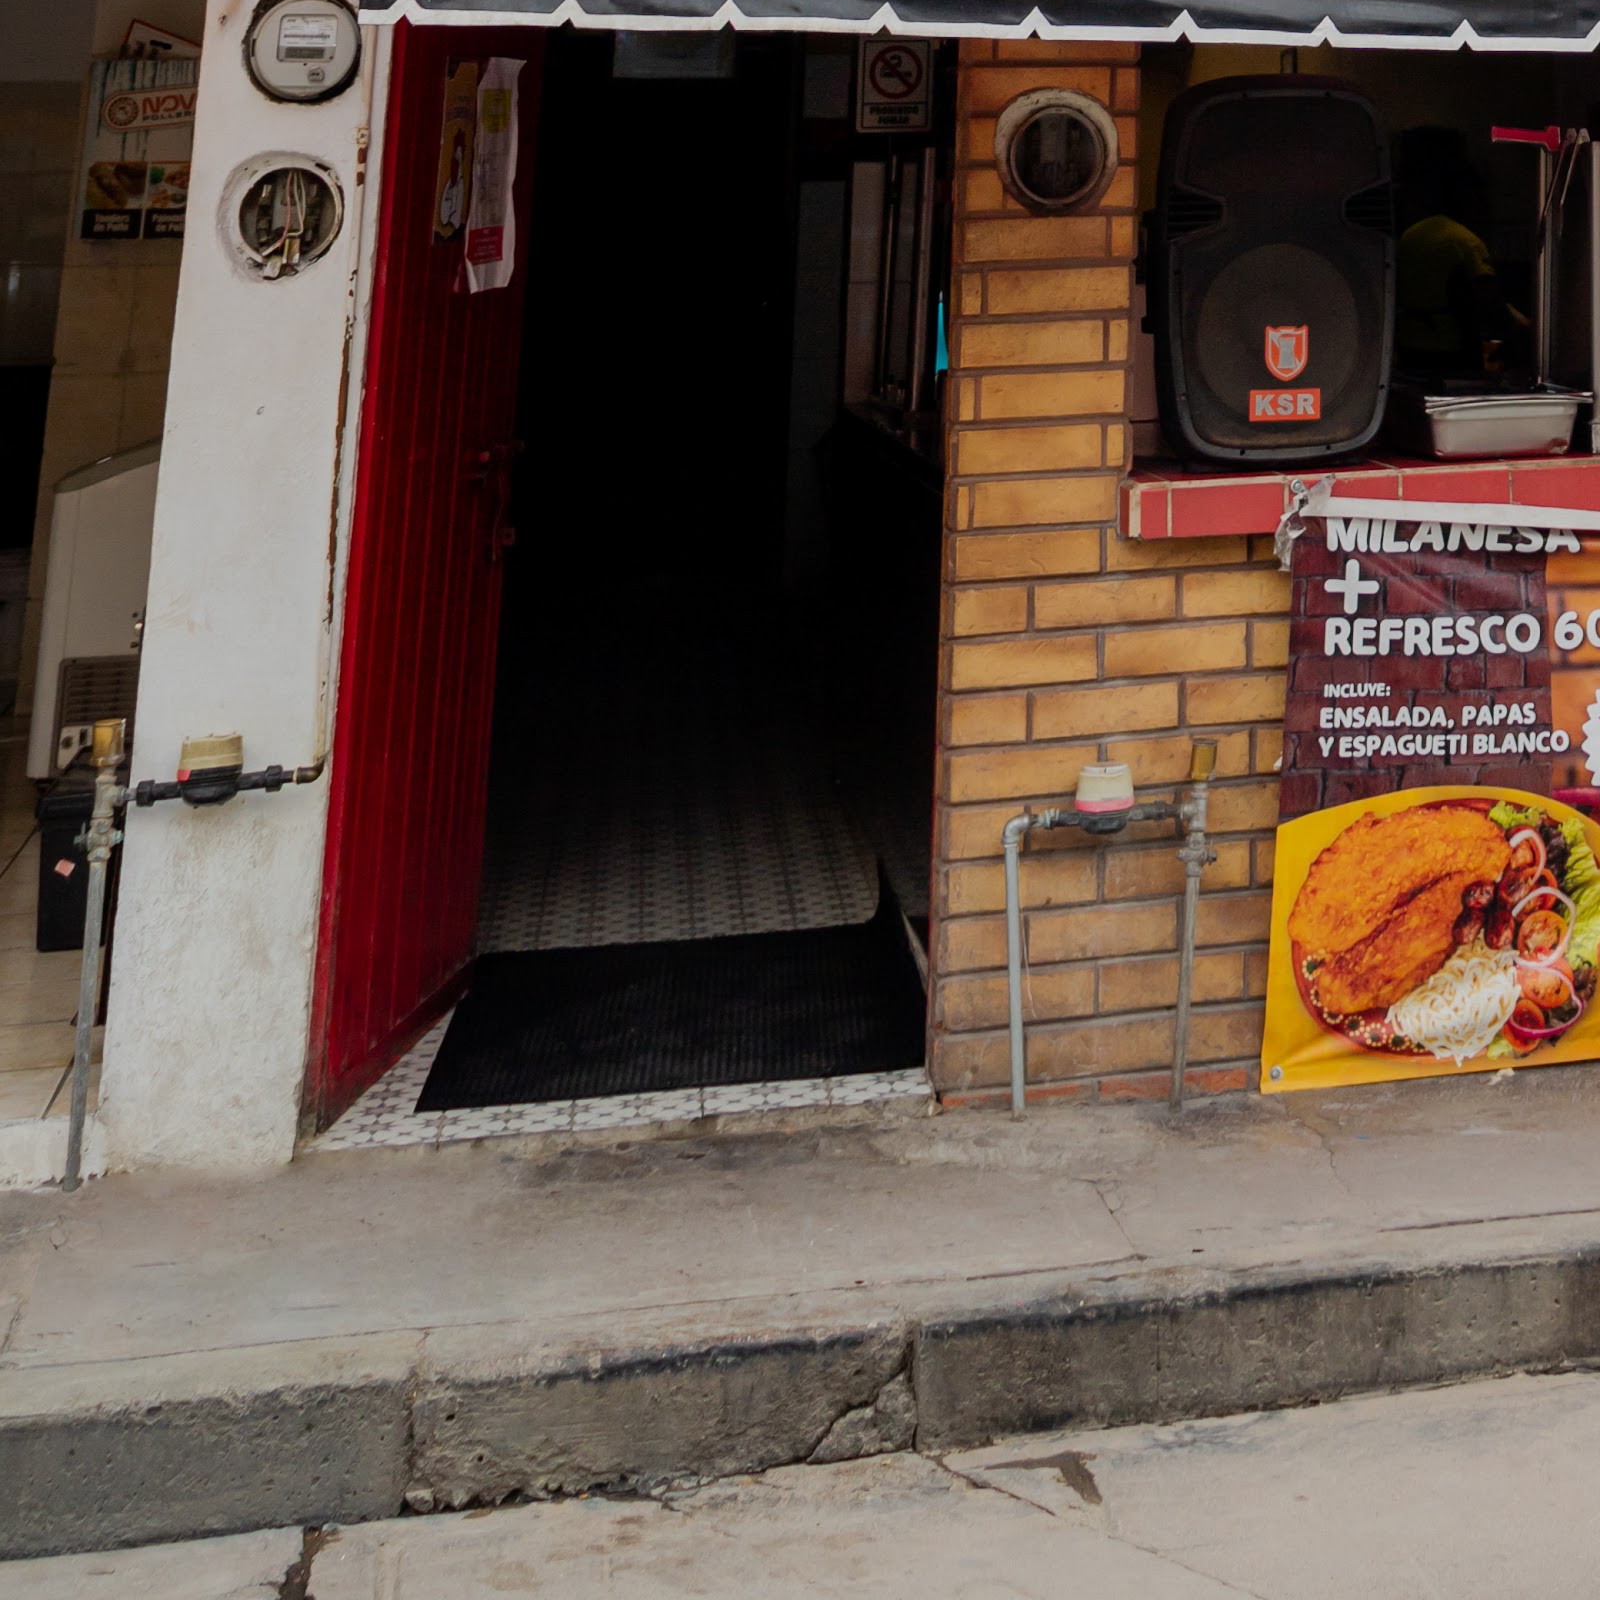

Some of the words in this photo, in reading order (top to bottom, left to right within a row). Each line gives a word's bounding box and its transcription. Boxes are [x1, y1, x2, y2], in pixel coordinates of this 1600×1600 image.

[1254, 393, 1316, 417] KSR
[1325, 516, 1581, 554] MILANESA
[1323, 612, 1542, 657] REFRESCO
[1323, 682, 1392, 699] INCLUYE:
[1319, 705, 1455, 729] ENSALADA,
[1461, 702, 1537, 727] PAPAS
[1318, 736, 1335, 758] Y
[1338, 733, 1468, 759] ESPAGUETI
[1472, 729, 1571, 756] BLANCO
